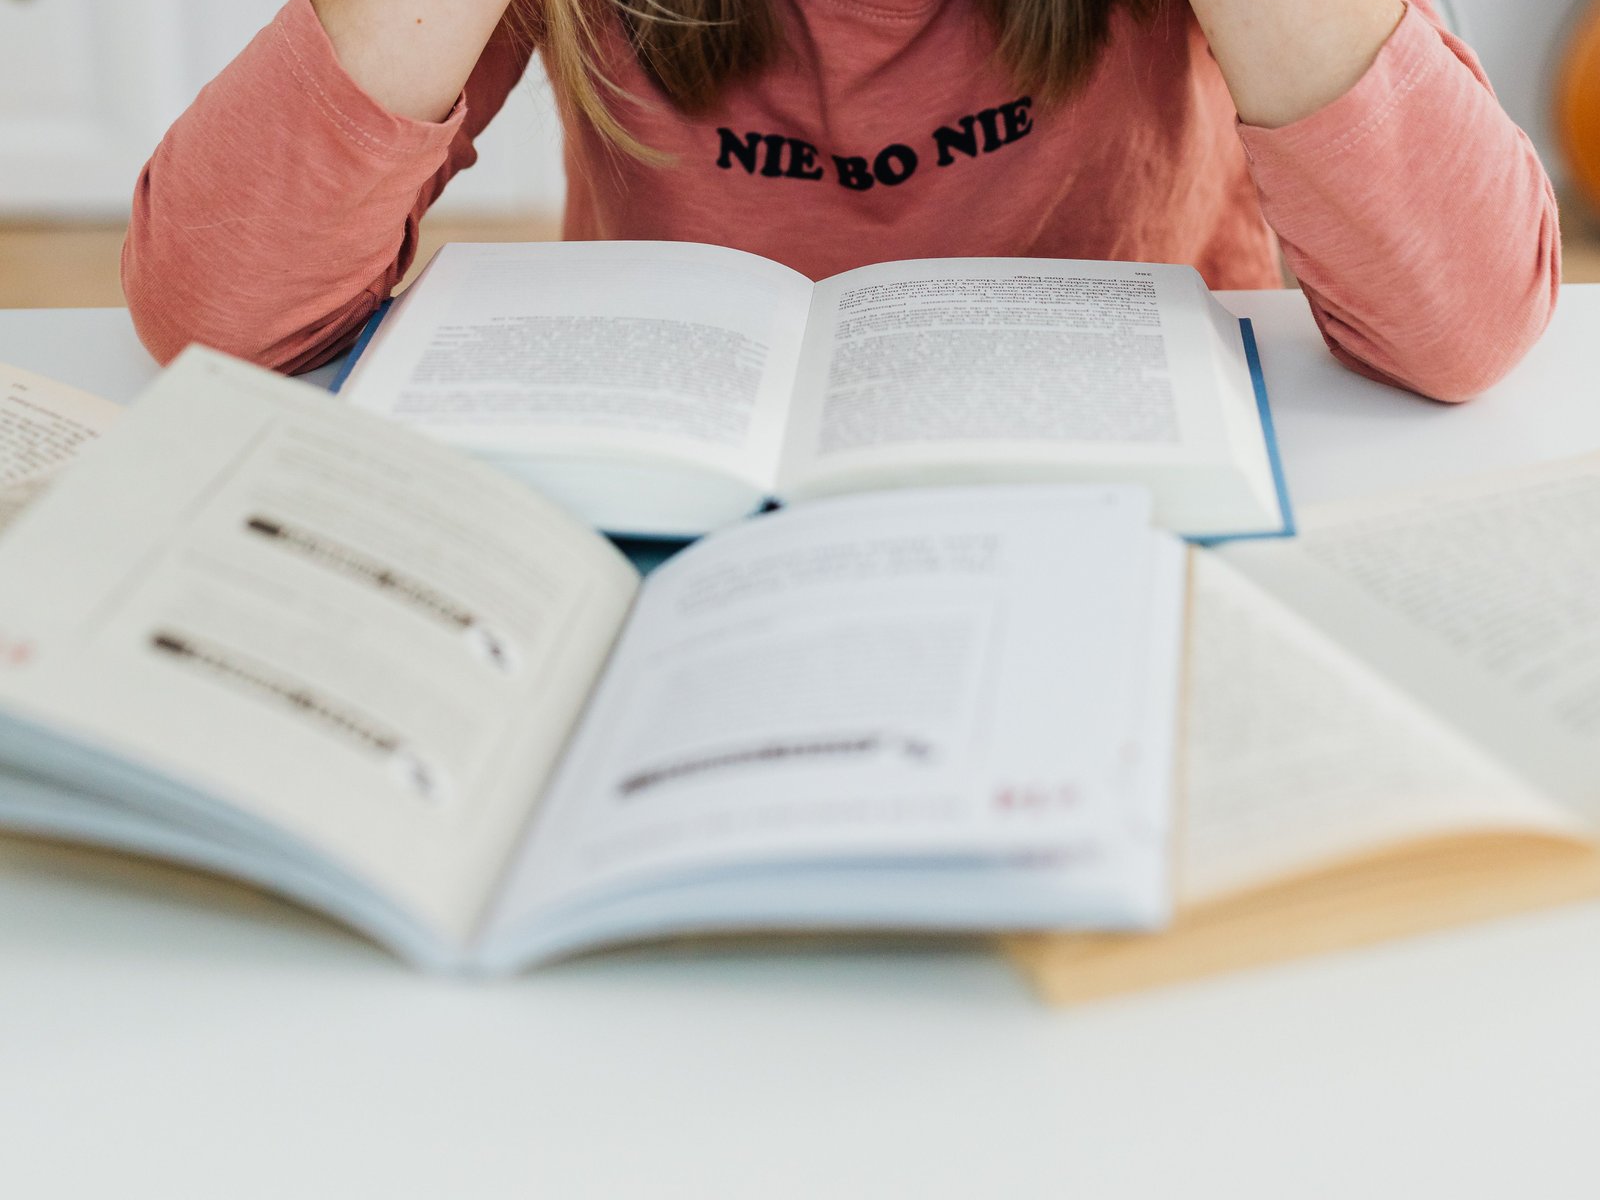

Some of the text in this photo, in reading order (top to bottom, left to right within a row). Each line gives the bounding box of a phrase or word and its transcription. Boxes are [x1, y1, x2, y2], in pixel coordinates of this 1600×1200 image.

[716, 96, 1033, 191] NIE BO NIE
